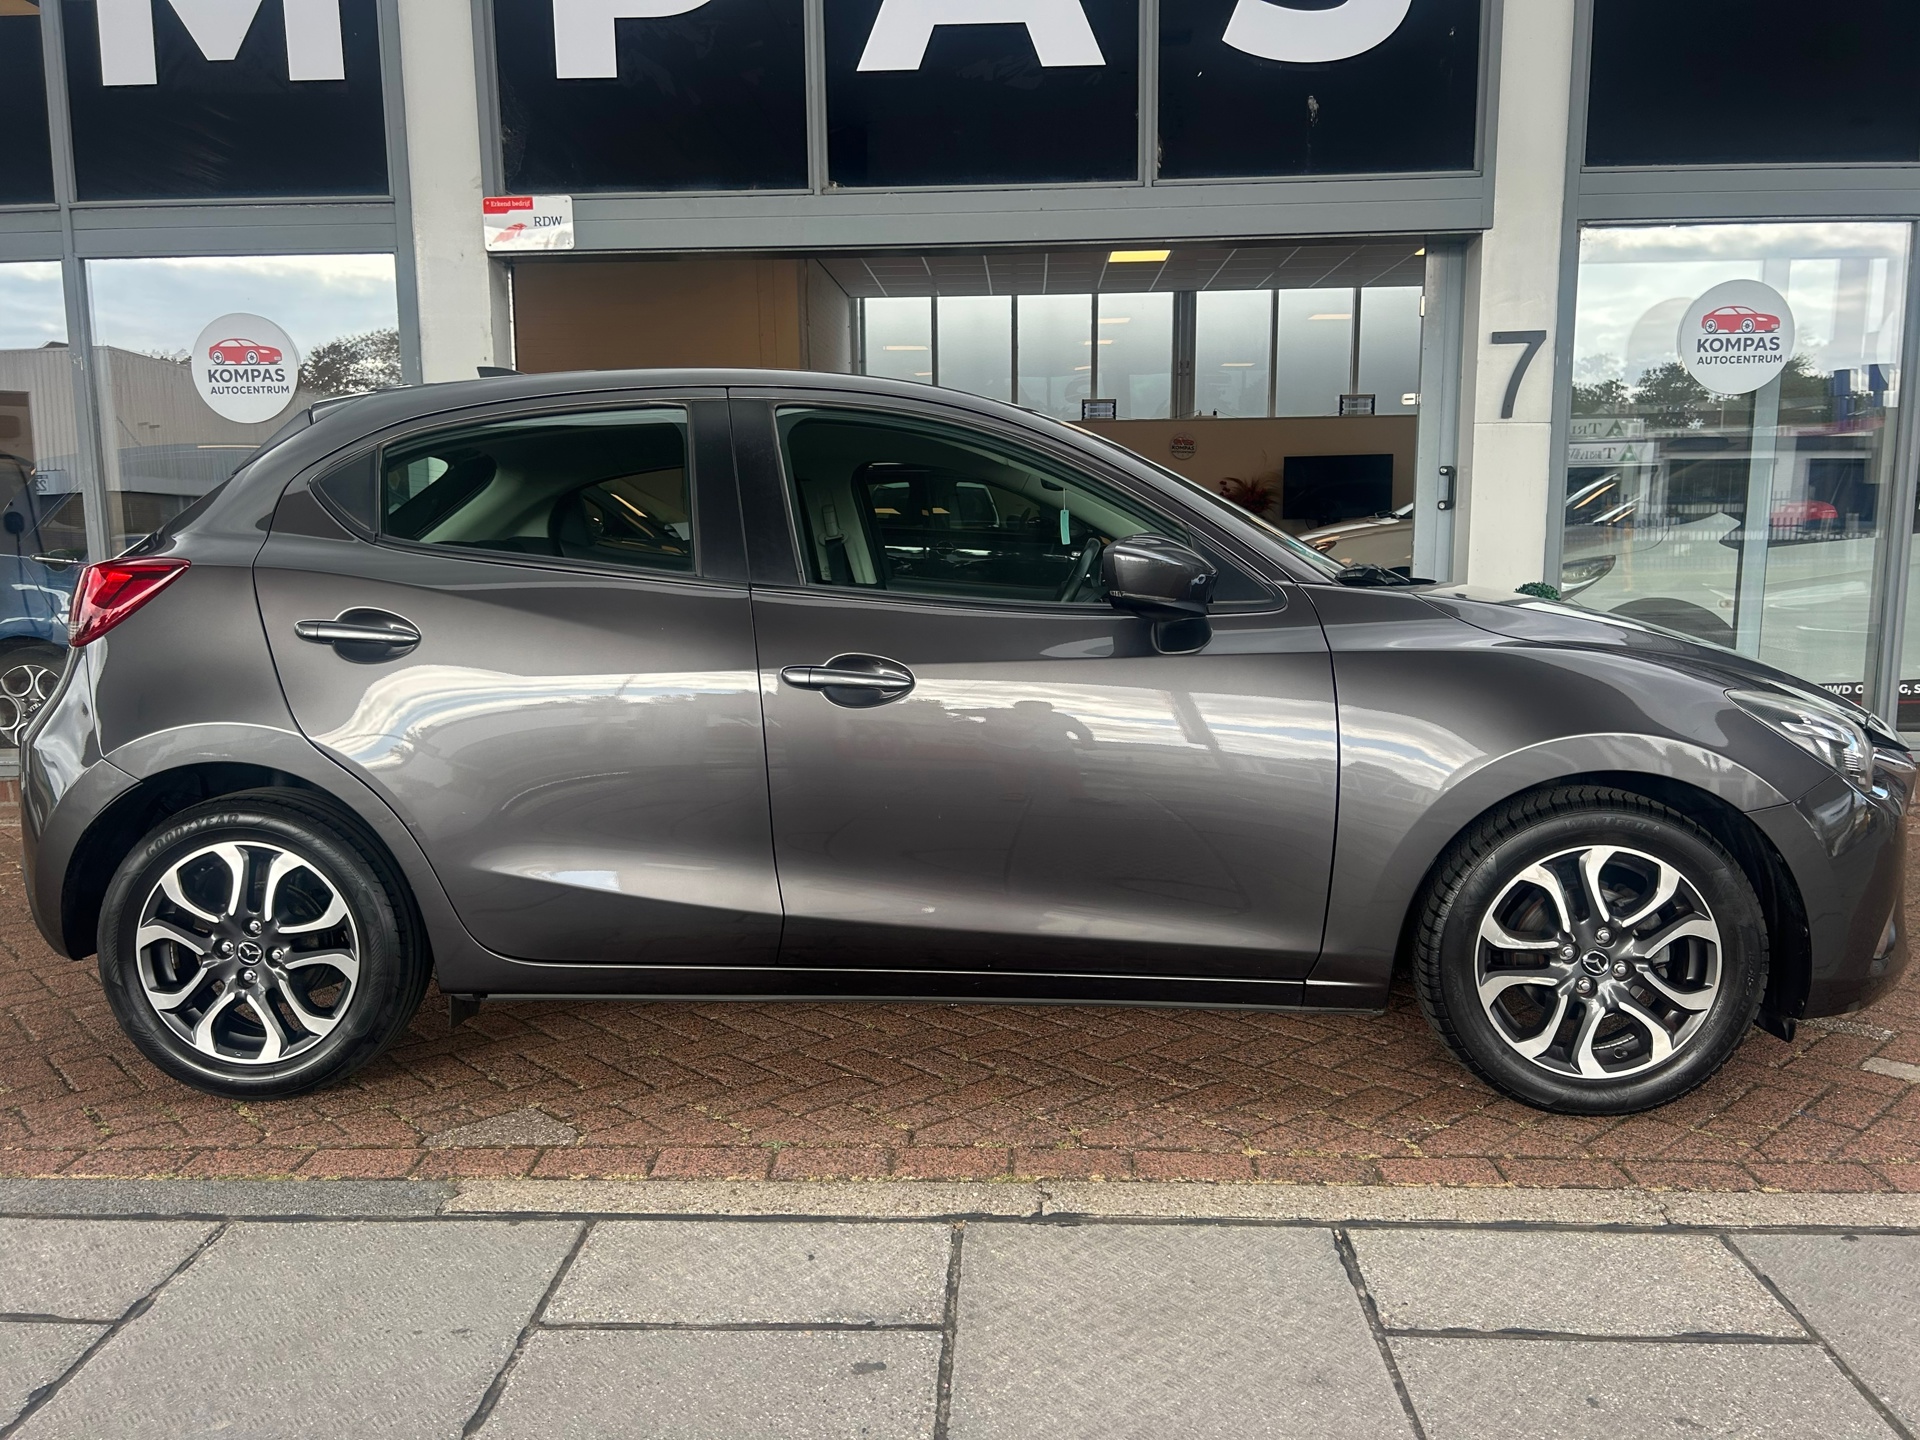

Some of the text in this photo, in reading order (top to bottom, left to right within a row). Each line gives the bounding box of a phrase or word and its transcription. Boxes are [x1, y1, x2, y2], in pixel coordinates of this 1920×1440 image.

[490, 200, 531, 208] Erkend bedrijf
[533, 215, 563, 227] RDW
[1696, 336, 1781, 353] KOMPAS
[1696, 354, 1783, 365] AUTOCENTRUM
[207, 368, 286, 383] KOMPAS
[1491, 330, 1547, 419] 7
[210, 385, 290, 395] AUTOCENTRUM
